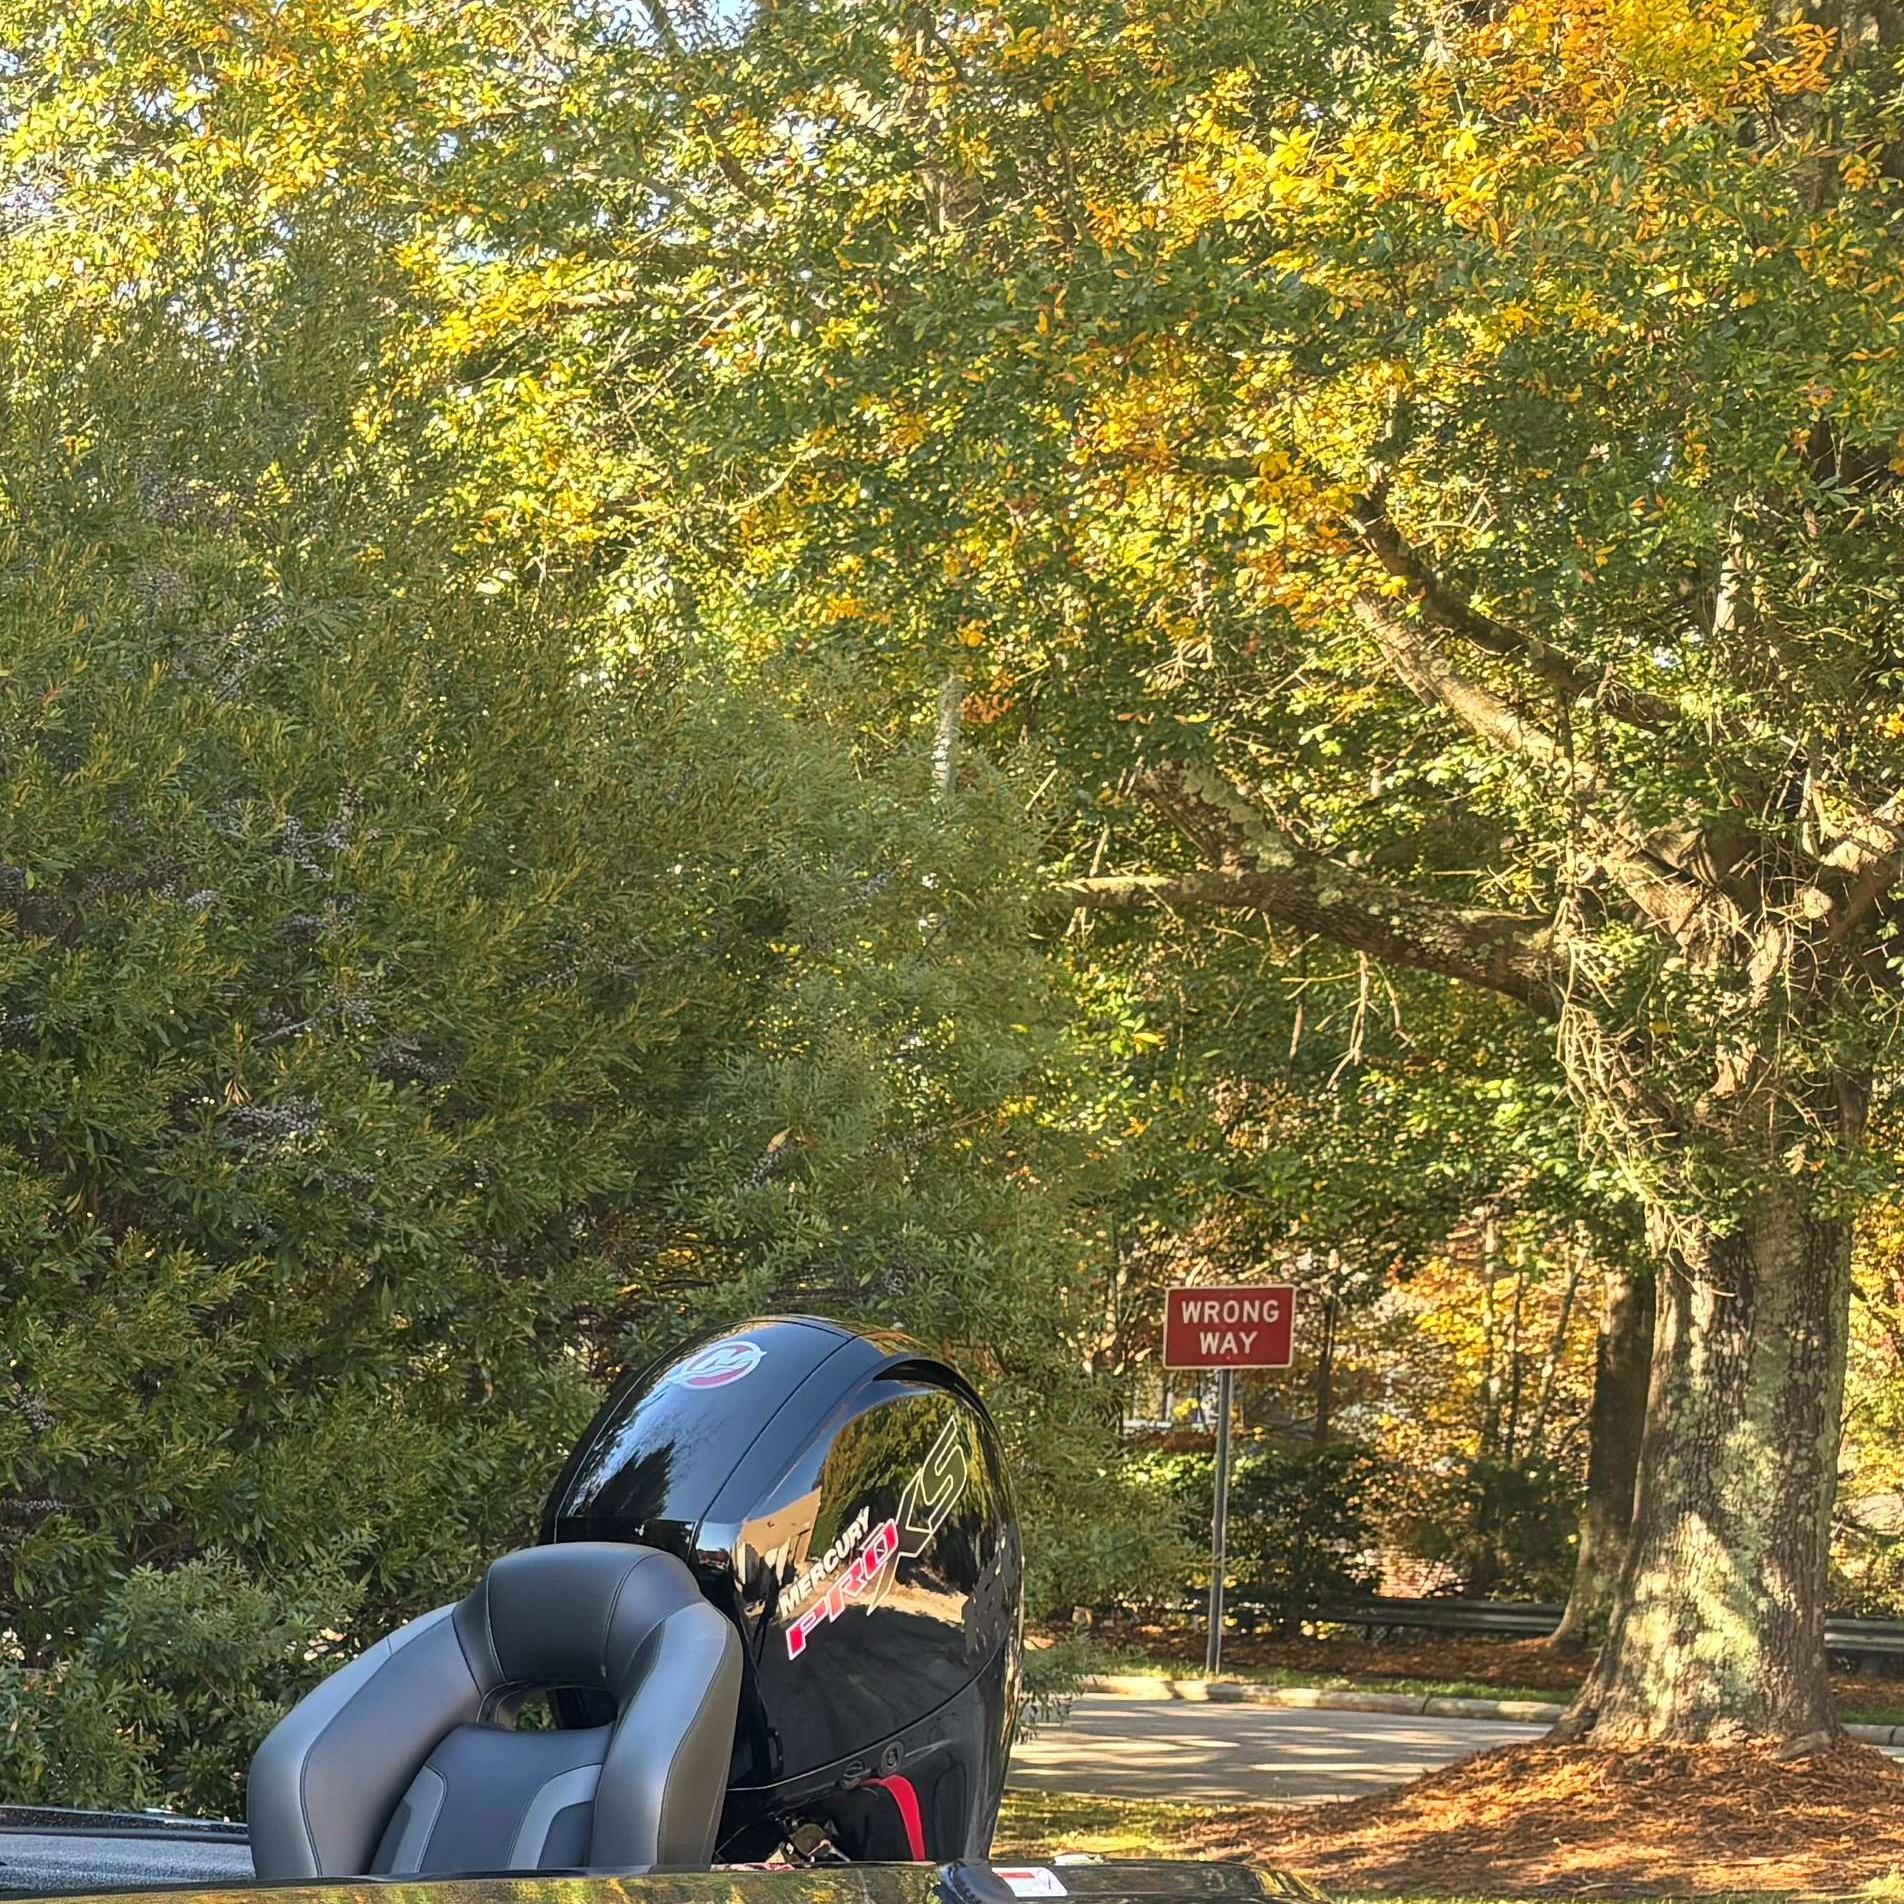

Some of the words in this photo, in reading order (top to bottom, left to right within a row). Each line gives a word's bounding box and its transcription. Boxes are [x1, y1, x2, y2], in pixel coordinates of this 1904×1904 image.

[1181, 1299, 1280, 1324] WRONG
[1199, 1331, 1258, 1355] WAY
[777, 1505, 870, 1620] MERCURY
[784, 1517, 900, 1661] PRO
[865, 1414, 968, 1618] XS
